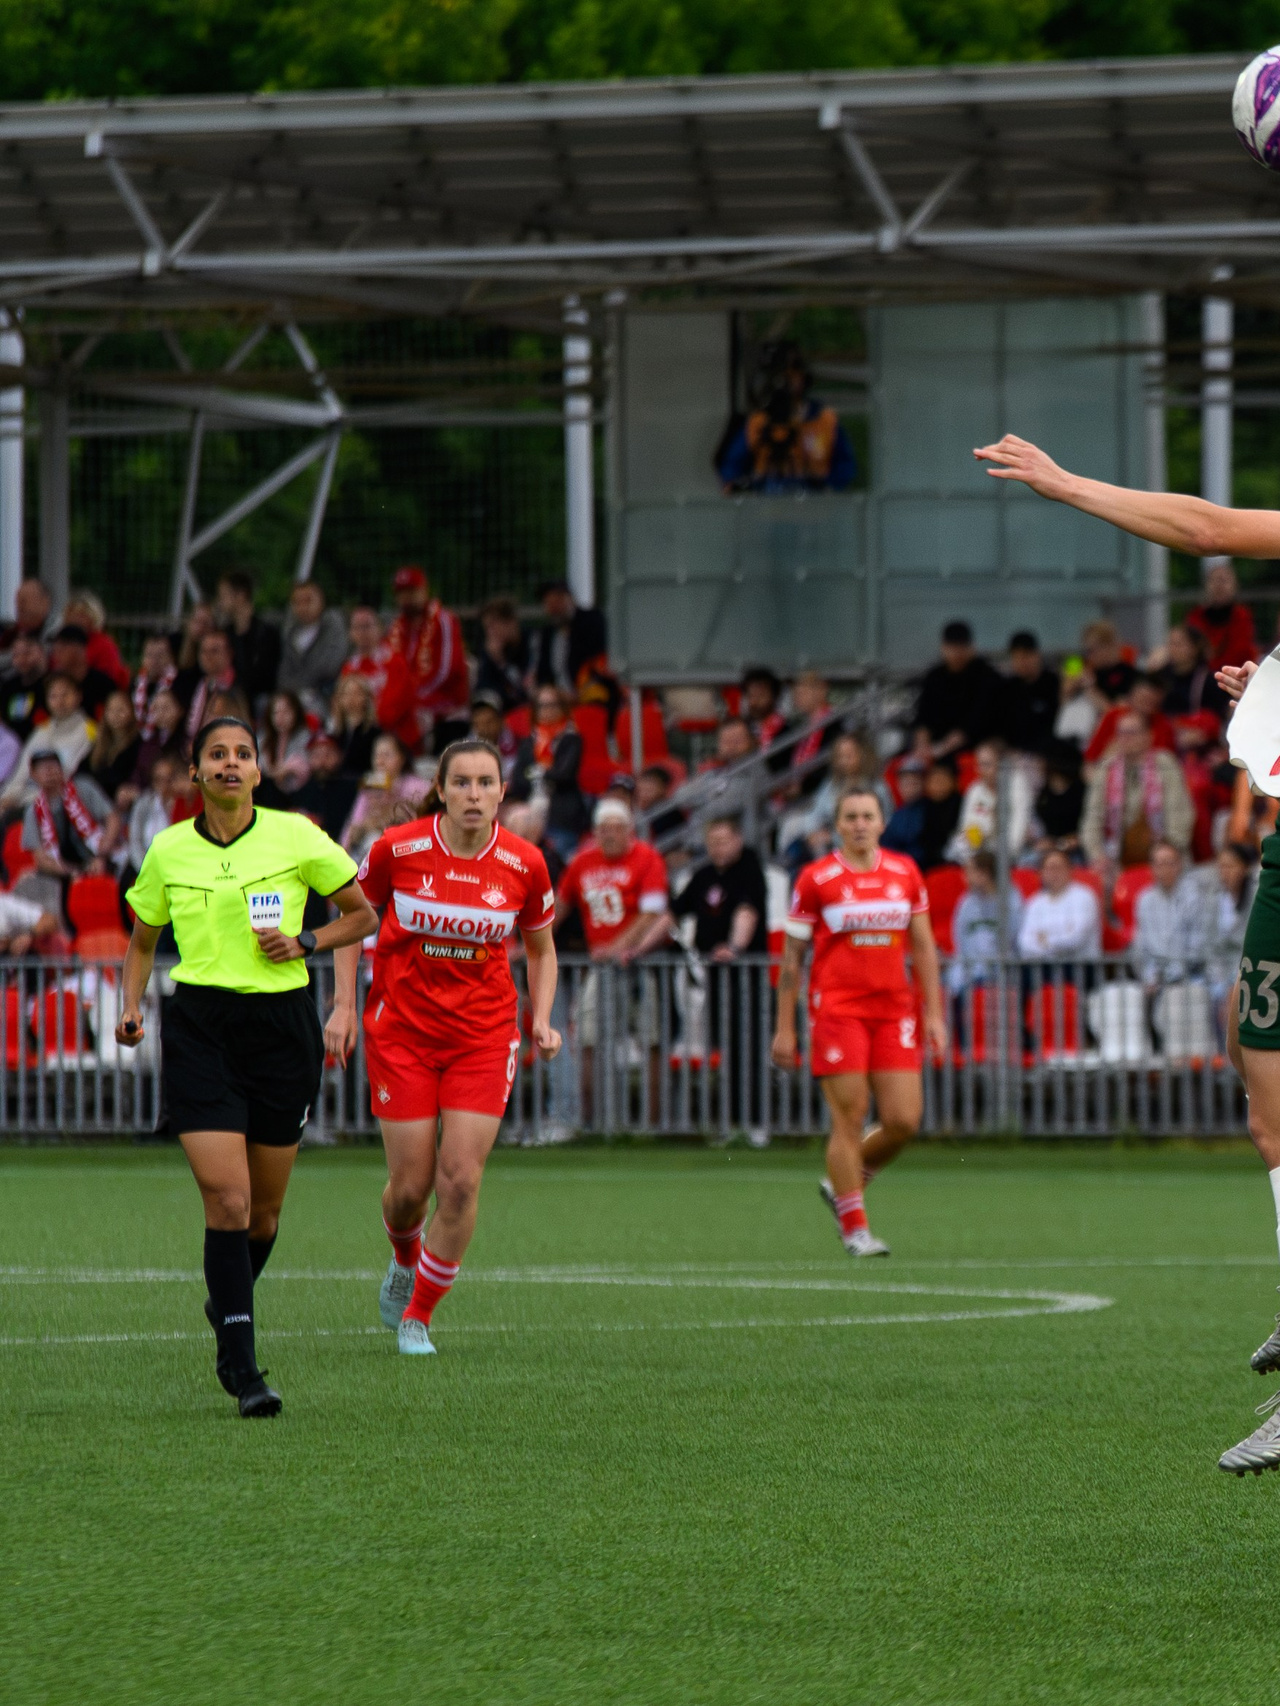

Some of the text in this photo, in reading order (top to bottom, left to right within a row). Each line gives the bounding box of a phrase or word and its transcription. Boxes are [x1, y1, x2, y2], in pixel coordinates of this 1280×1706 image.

[252, 894, 281, 907] FIFA
[410, 909, 506, 940] ЛУКОЙЛ
[424, 943, 475, 960] WINLINE
